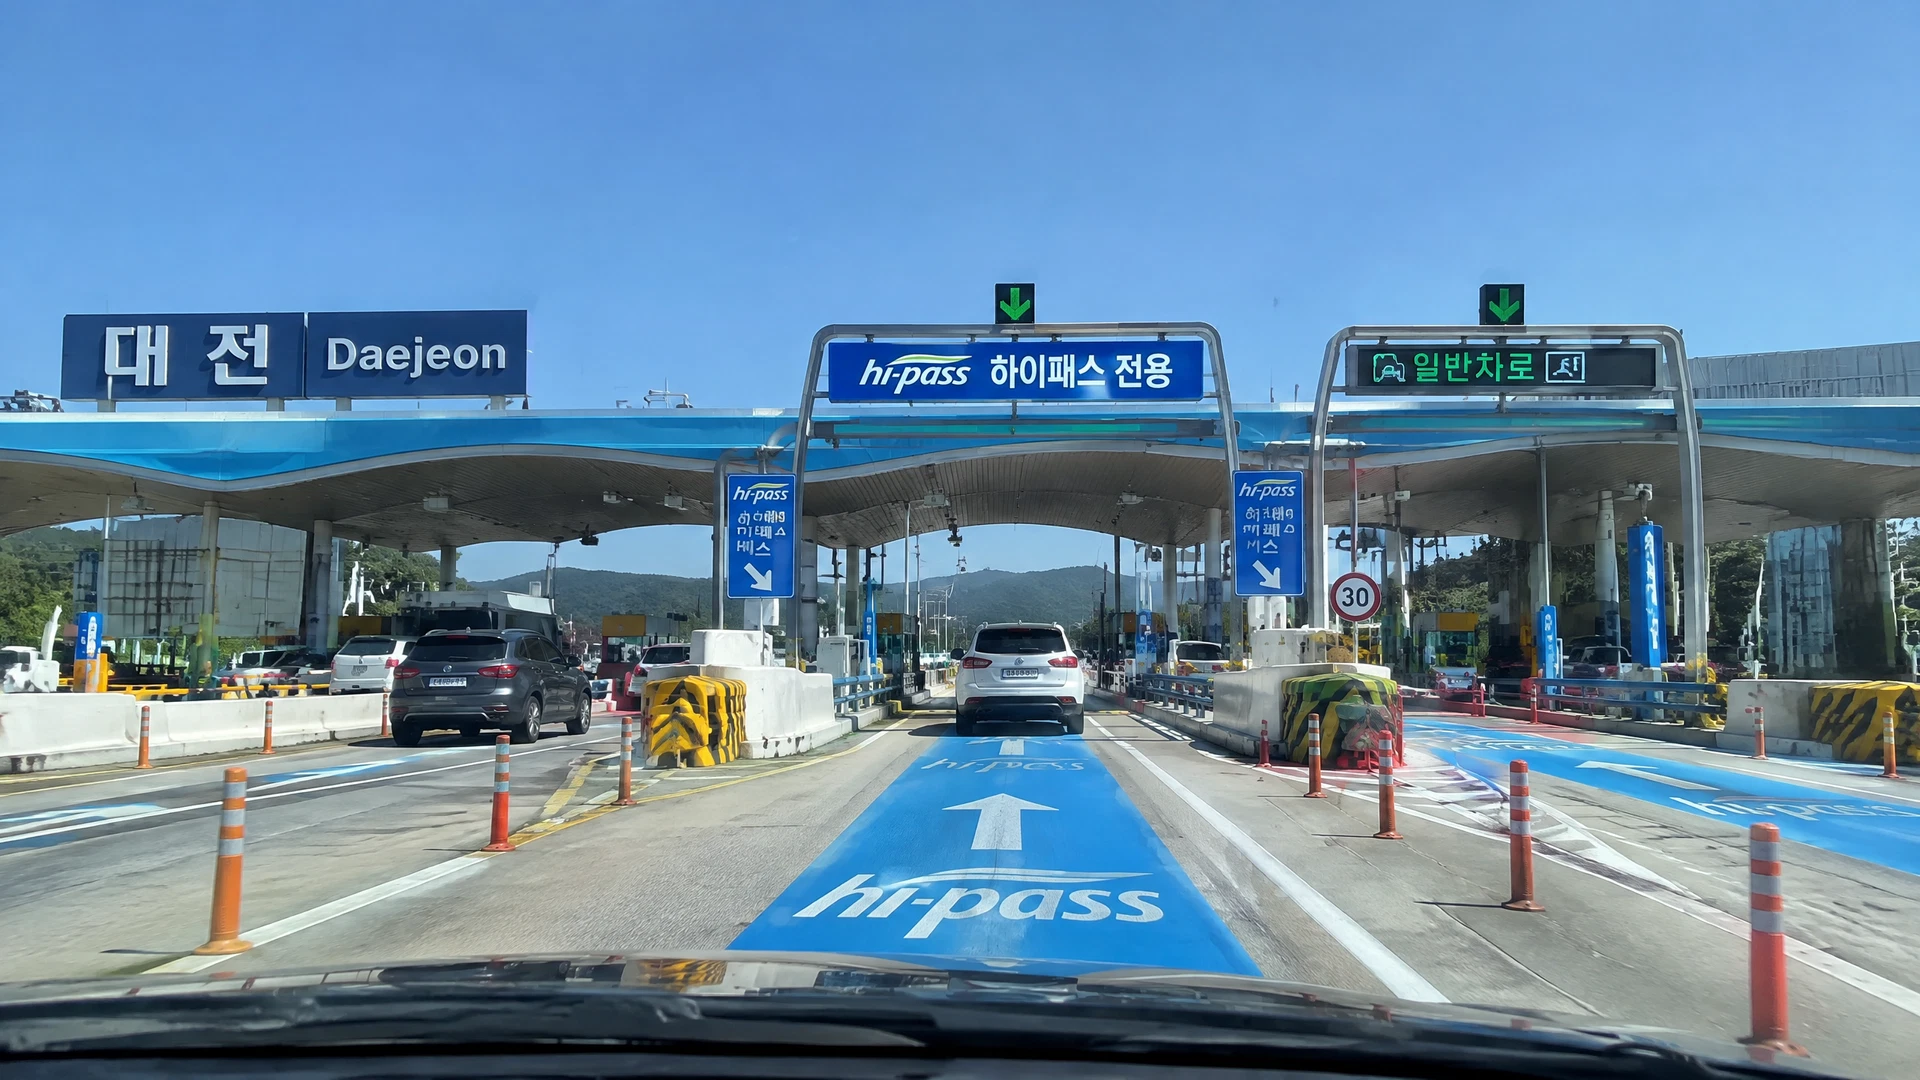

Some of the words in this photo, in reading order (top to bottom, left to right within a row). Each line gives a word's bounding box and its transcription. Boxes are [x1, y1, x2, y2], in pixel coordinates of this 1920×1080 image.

[327, 336, 506, 378] Daejeon
[1413, 351, 1535, 382] 일반차로
[859, 355, 972, 394] hi-pass
[991, 354, 1105, 389] 하이패스
[1114, 353, 1173, 389] 전용
[733, 483, 789, 505] hi-pass
[1238, 479, 1297, 501] hi-pass
[1342, 587, 1369, 607] 30
[793, 867, 1164, 939] hi-pass
